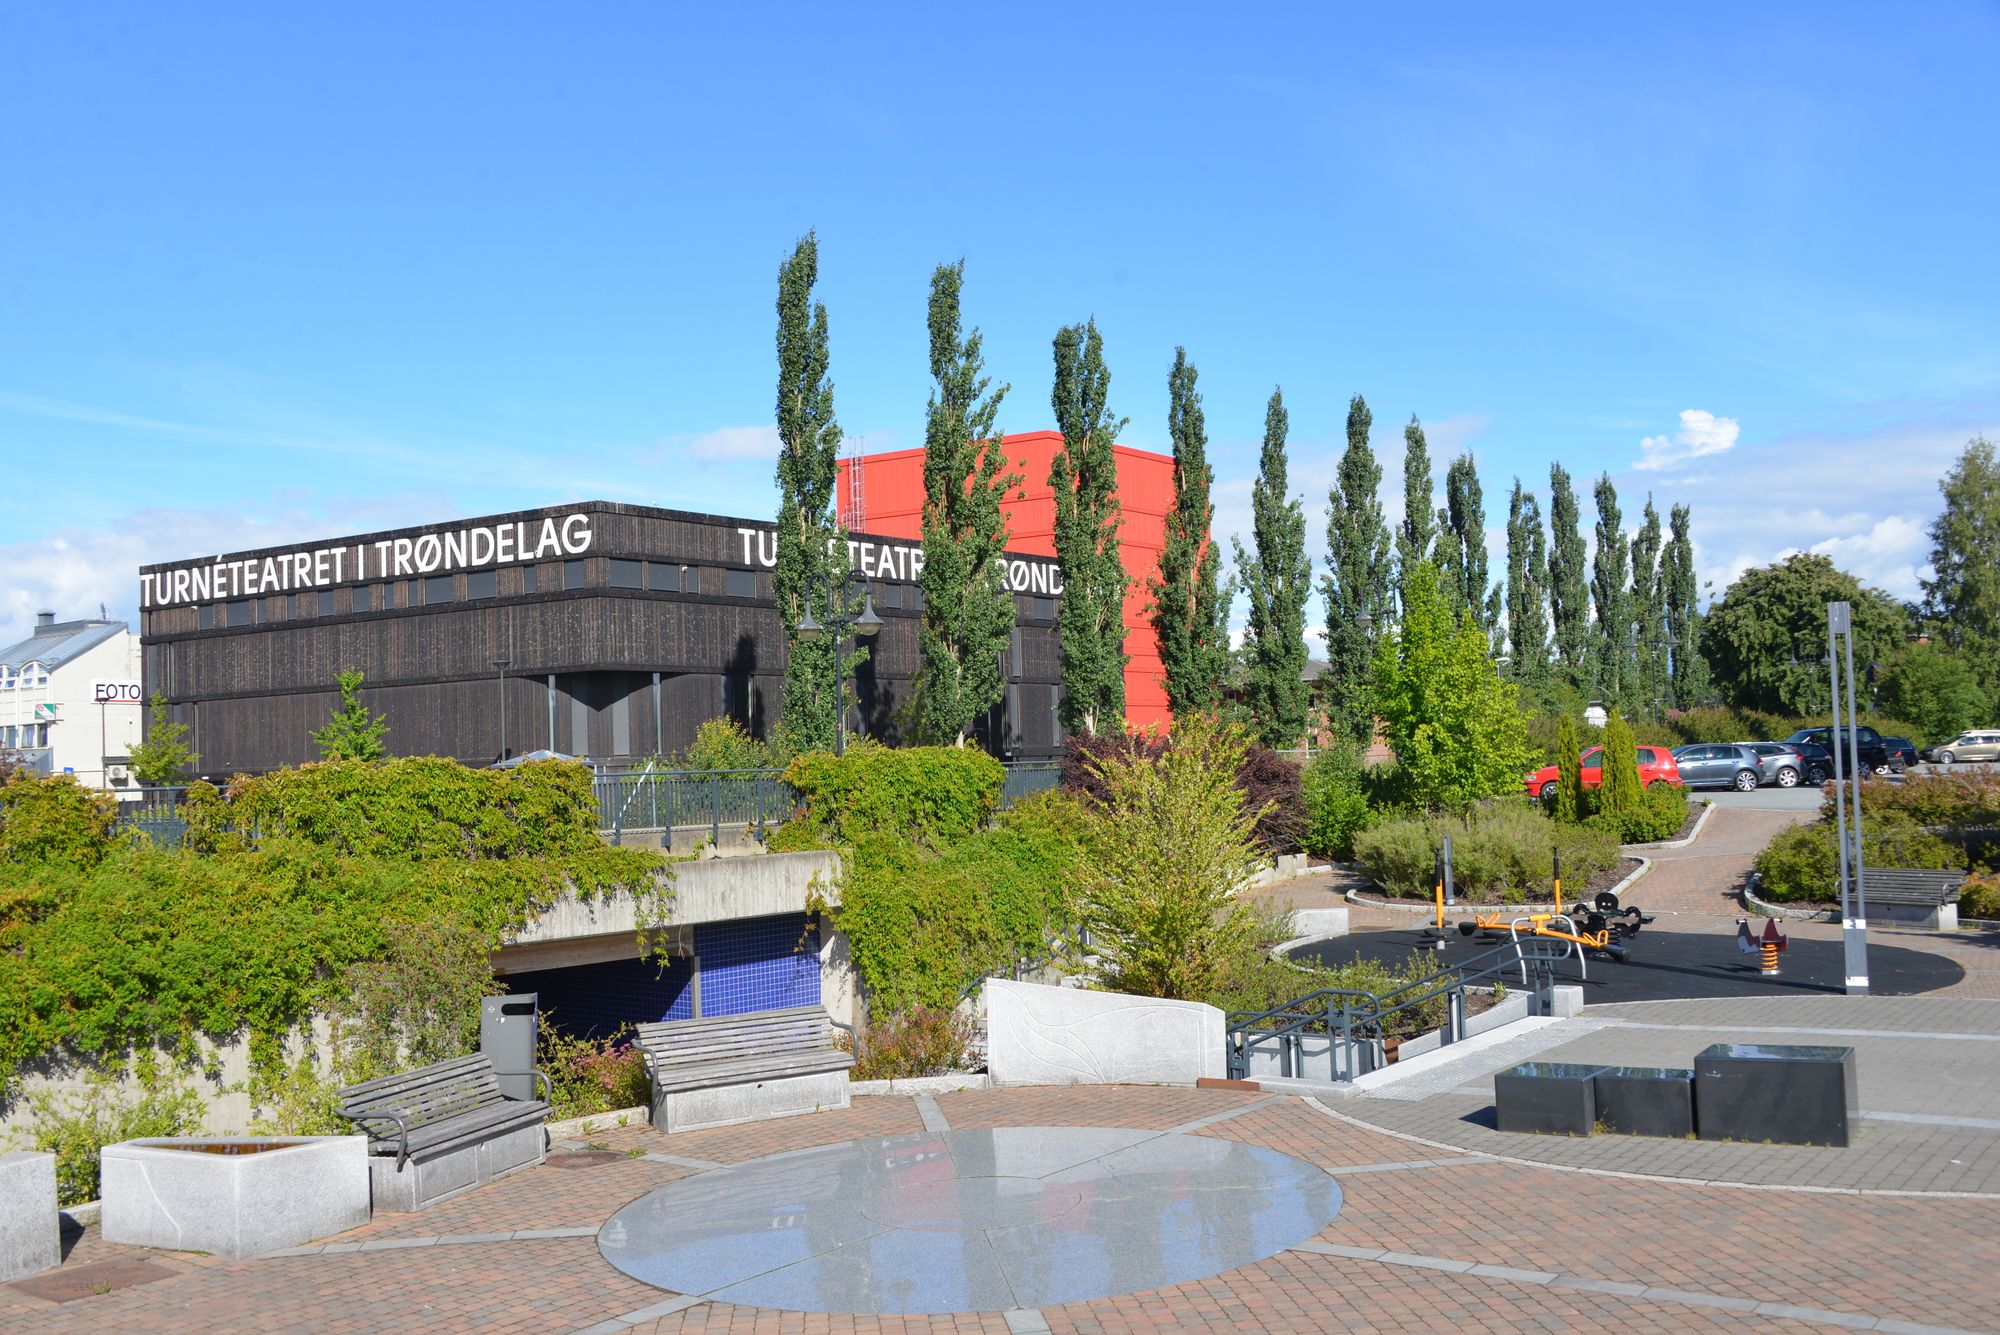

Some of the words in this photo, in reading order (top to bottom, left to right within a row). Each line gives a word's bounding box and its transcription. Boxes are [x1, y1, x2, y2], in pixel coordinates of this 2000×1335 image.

[141, 547, 346, 607] TURNÉTEATRET
[376, 513, 592, 577] TRØNDELAG
[96, 684, 140, 699] FOTO
